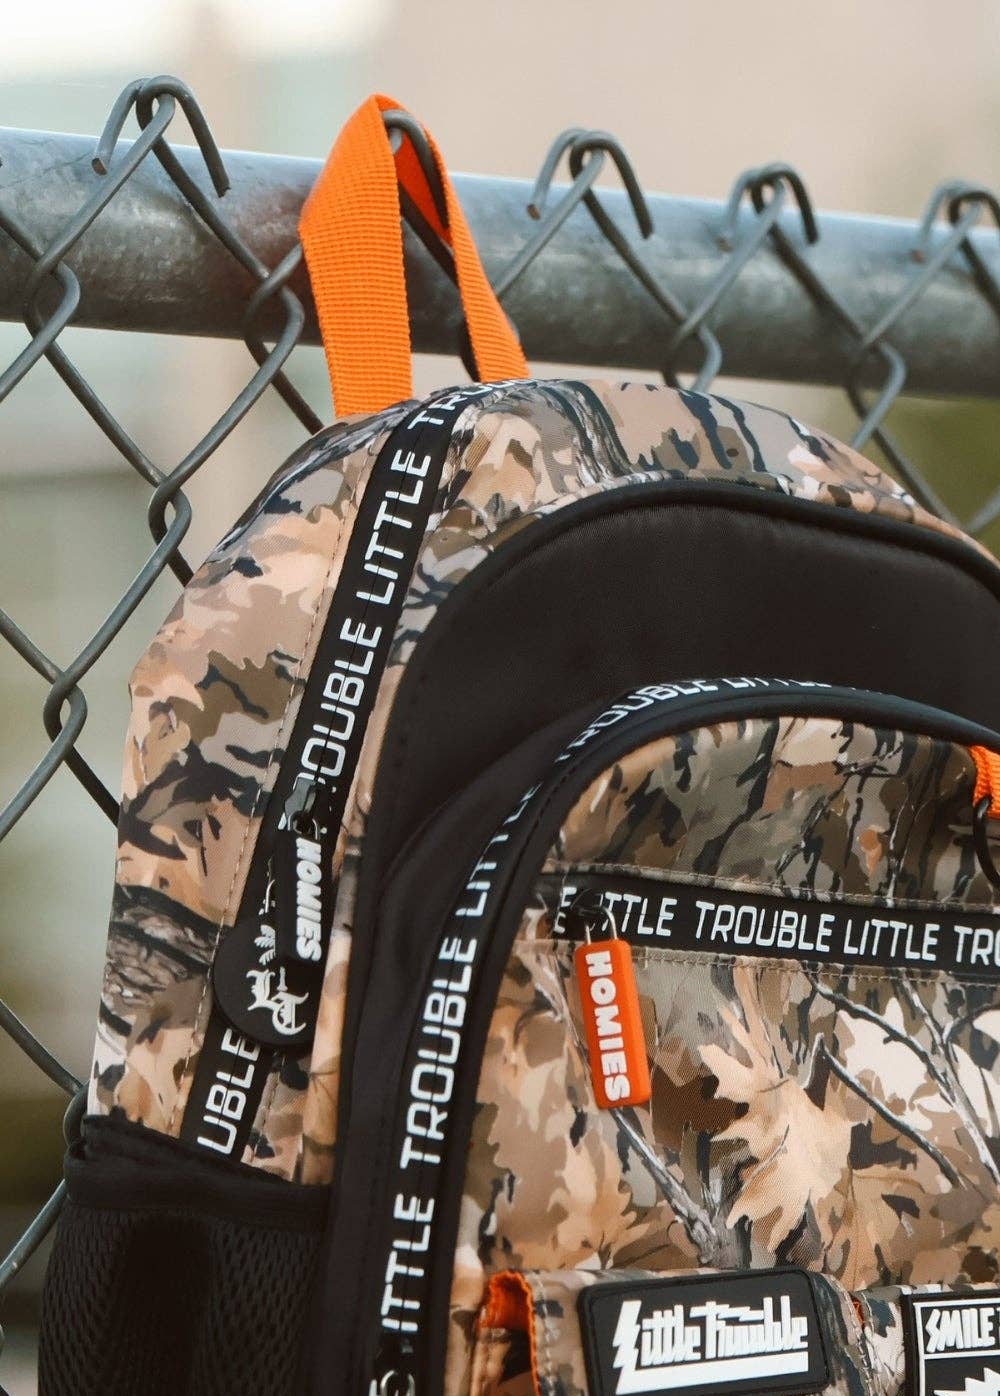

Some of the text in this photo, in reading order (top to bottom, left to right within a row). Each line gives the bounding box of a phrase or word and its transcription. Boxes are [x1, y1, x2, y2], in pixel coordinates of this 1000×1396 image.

[277, 617, 382, 832] OUBLE
[356, 449, 431, 605] LITTLE
[296, 838, 321, 962] HOMIES
[600, 891, 678, 937] TTLE
[695, 900, 835, 954] TROUBLE
[844, 917, 940, 962] LITTLE
[400, 937, 478, 1169] TROUBLE
[585, 949, 630, 1102] HOMIES
[381, 1193, 435, 1345] ITTLE
[925, 1307, 996, 1353] SMILE
